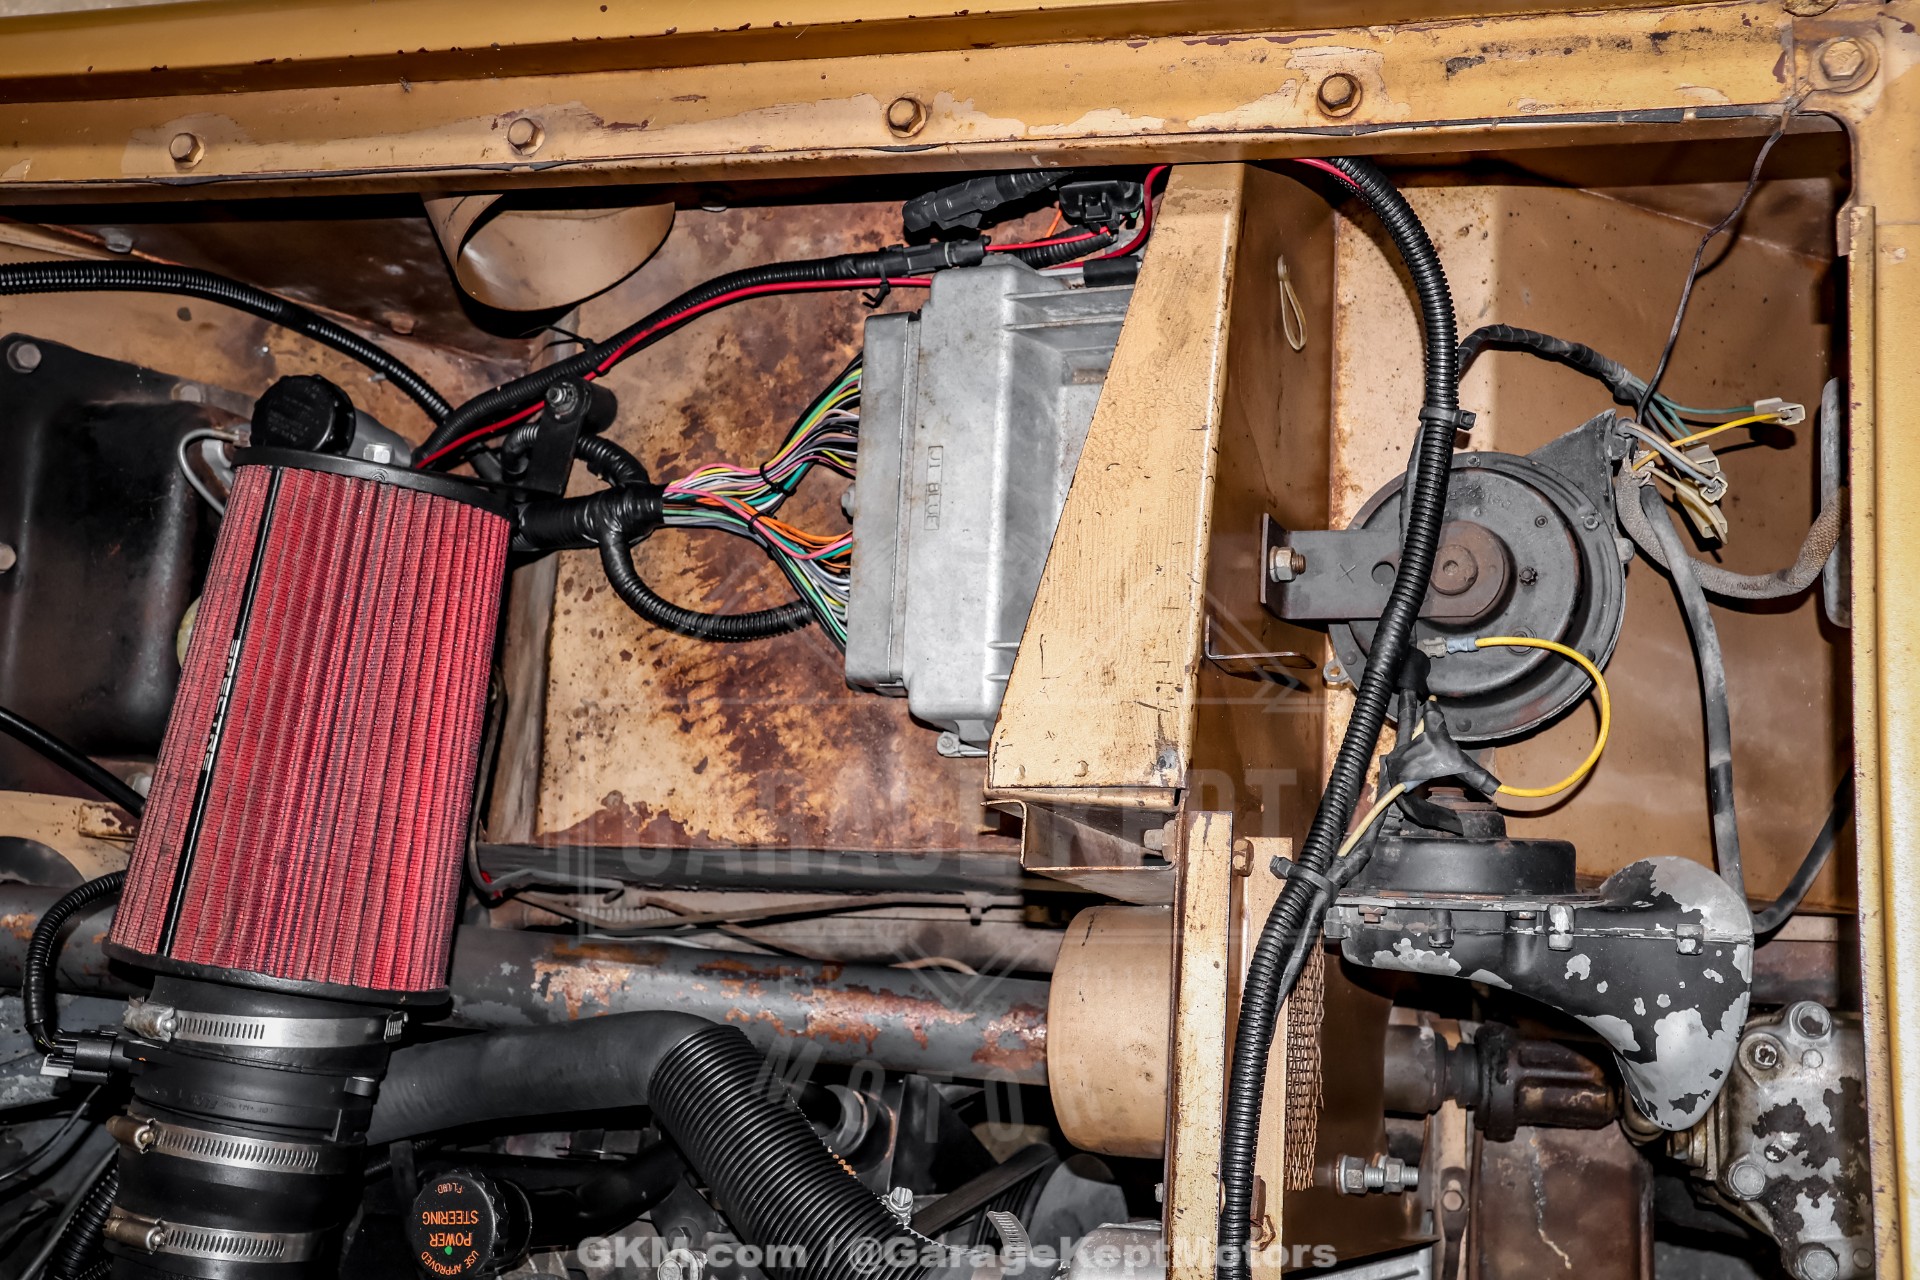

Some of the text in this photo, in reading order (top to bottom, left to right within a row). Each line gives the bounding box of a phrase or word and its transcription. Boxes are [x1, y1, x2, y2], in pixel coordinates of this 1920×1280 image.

[925, 482, 940, 527] BLUE
[202, 639, 240, 772] SPECTRE
[437, 1182, 463, 1194] FLUID
[422, 1210, 479, 1225] STEERING
[429, 1232, 472, 1247] POWER
[421, 1250, 480, 1276] USE APPROVED
